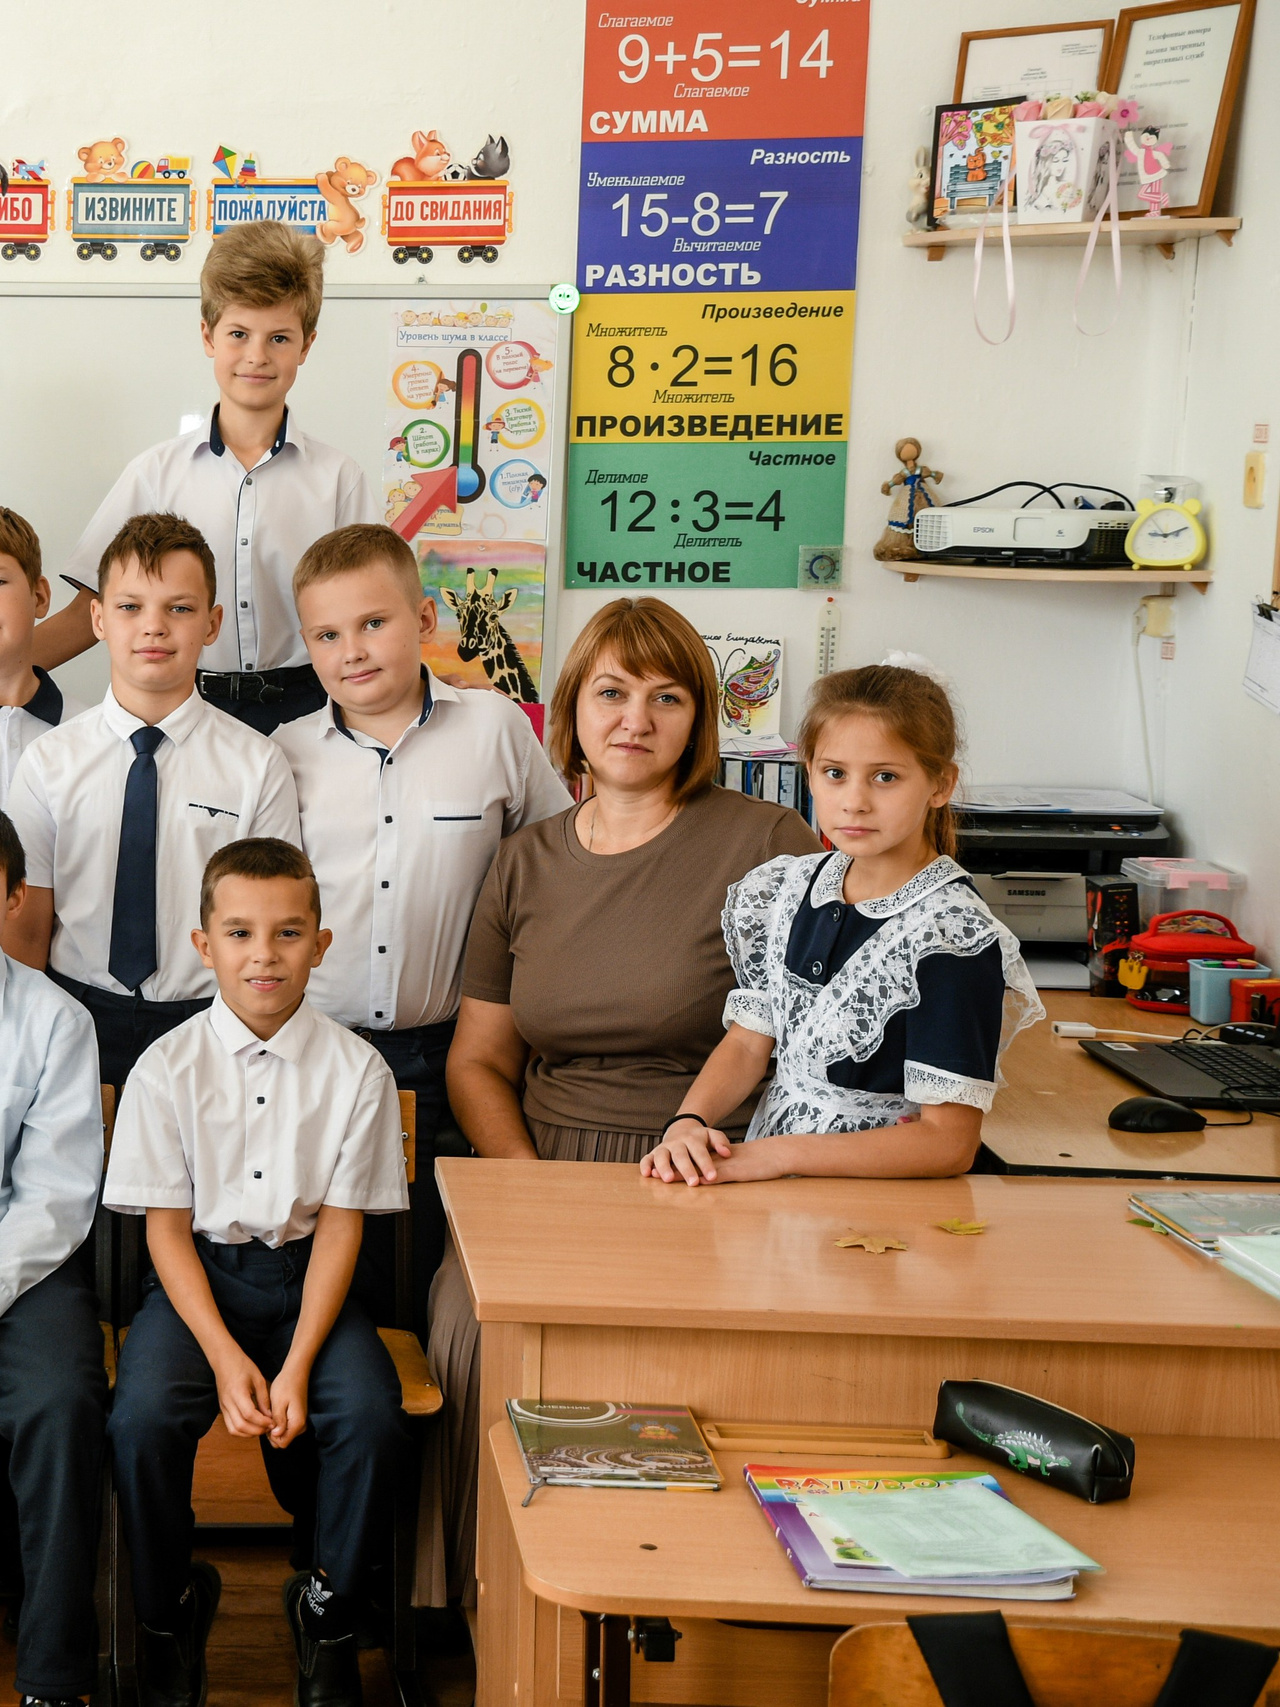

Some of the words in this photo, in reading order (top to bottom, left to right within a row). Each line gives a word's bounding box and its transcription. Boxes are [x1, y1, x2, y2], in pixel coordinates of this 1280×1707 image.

[598, 13, 673, 28] Слагаемое
[618, 29, 834, 84] 9+5=14
[673, 83, 750, 98] Слагаемое
[589, 109, 708, 135] СУММА
[750, 149, 851, 165] Разность
[587, 172, 685, 188] Уменьшаемое
[84, 197, 177, 222] ИЗВИНИТЕ
[217, 196, 327, 222] ПОЖАЛУЙСТА
[392, 201, 415, 222] ДО
[420, 199, 502, 222] СВИДАНИЯ
[612, 190, 789, 237] 15-8=7
[672, 237, 761, 253] Вычитаемое
[585, 262, 762, 287] РАЗНОСТЬ
[701, 302, 844, 323] Произведение
[399, 330, 439, 342] Уровень
[441, 334, 467, 344] шума
[478, 334, 509, 342] классе
[585, 323, 668, 338] Множитель
[652, 390, 735, 404] Множитель
[575, 413, 844, 441] ПРОИЗВЕДЕНИЕ
[413, 441, 438, 449] (работа
[748, 451, 836, 466] Частное
[584, 469, 649, 485] Делимое
[673, 533, 742, 549] Делитель
[576, 561, 731, 583] ЧАСТНОЕ
[774, 1476, 953, 1492] RAINBO
